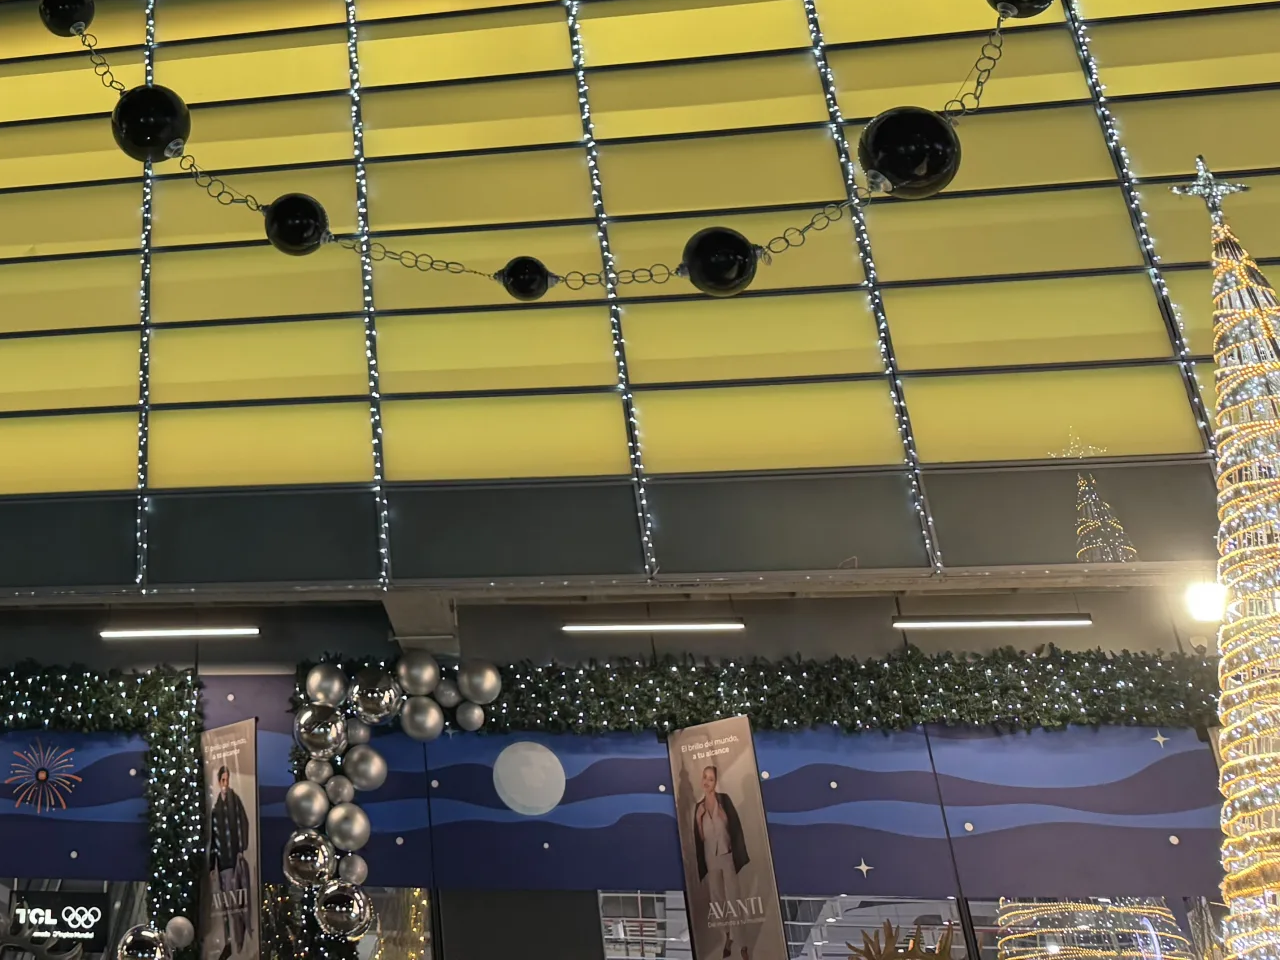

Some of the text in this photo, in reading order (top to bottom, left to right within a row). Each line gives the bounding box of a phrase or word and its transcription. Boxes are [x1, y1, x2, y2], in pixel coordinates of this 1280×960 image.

[688, 742, 704, 751] brillo
[704, 739, 714, 748] del
[714, 734, 739, 746] mundo,
[706, 746, 730, 757] alcance
[15, 907, 58, 925] TCL
[707, 896, 764, 919] AVANTI
